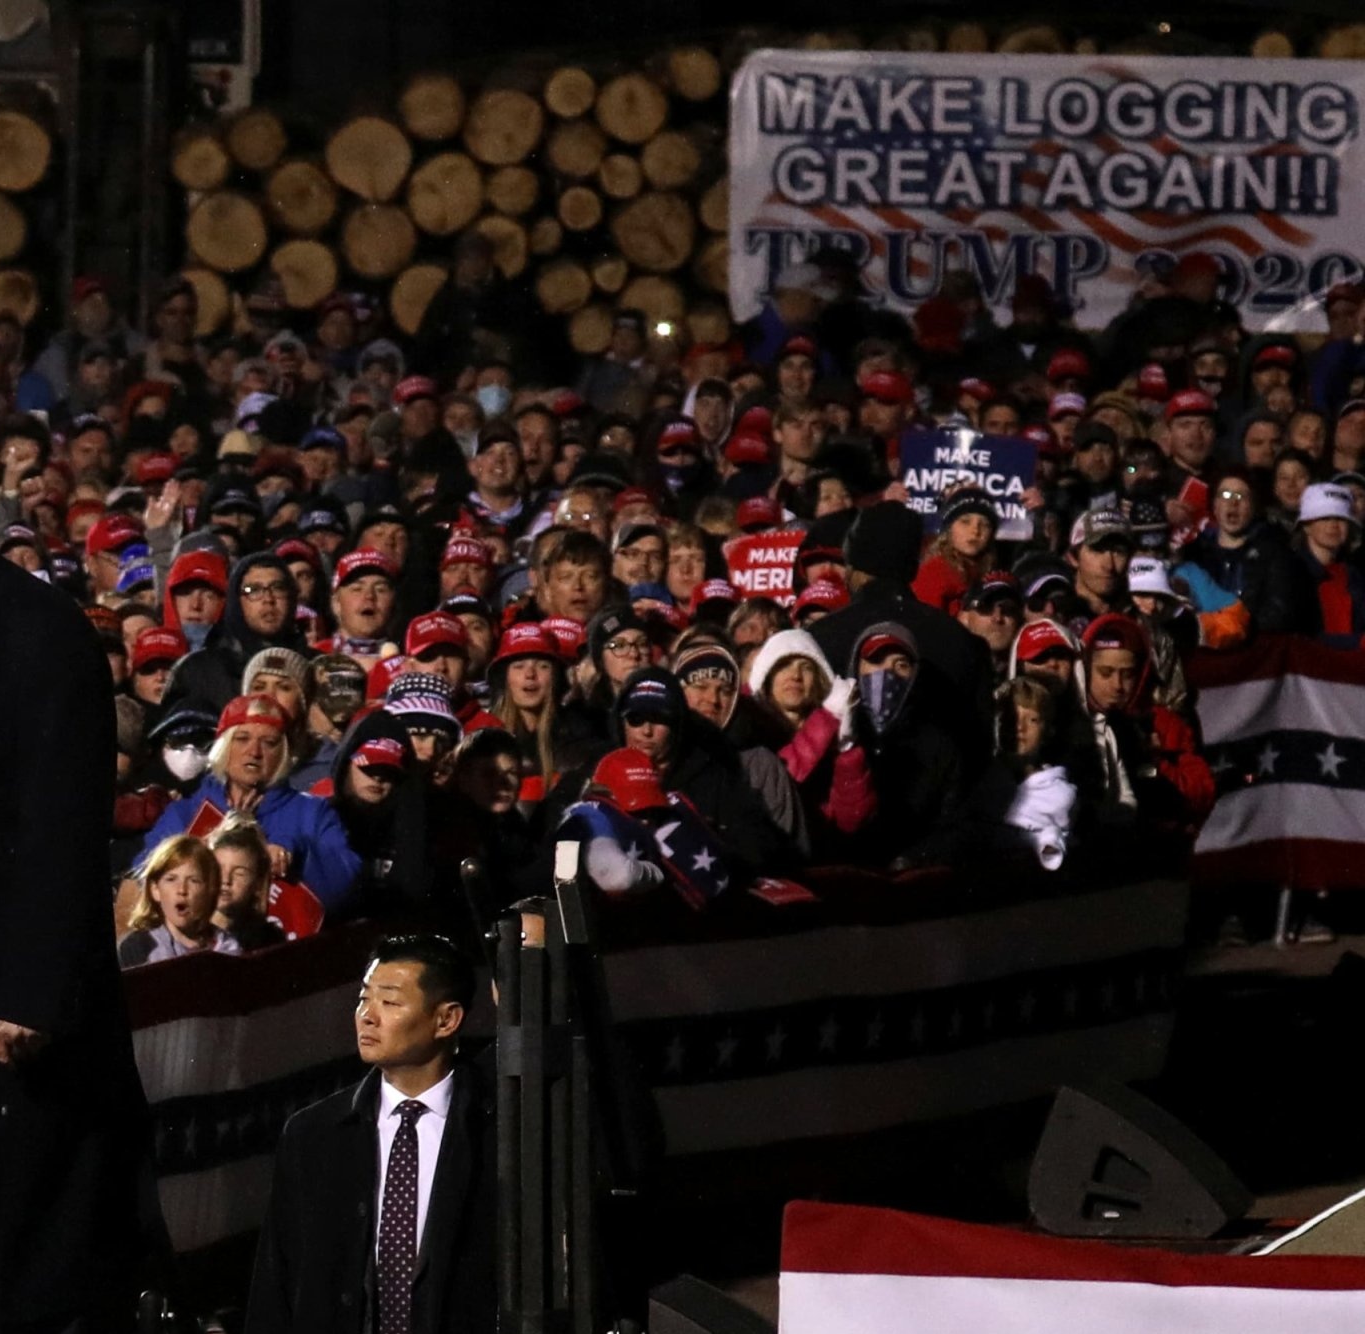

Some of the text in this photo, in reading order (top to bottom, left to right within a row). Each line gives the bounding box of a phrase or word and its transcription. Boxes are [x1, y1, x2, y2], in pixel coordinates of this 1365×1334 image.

[761, 74, 1352, 142] MAKE LOGGING
[775, 146, 1335, 212] GREAT AGAIN!!
[934, 447, 991, 467] MAKE
[732, 567, 795, 592] MERI
